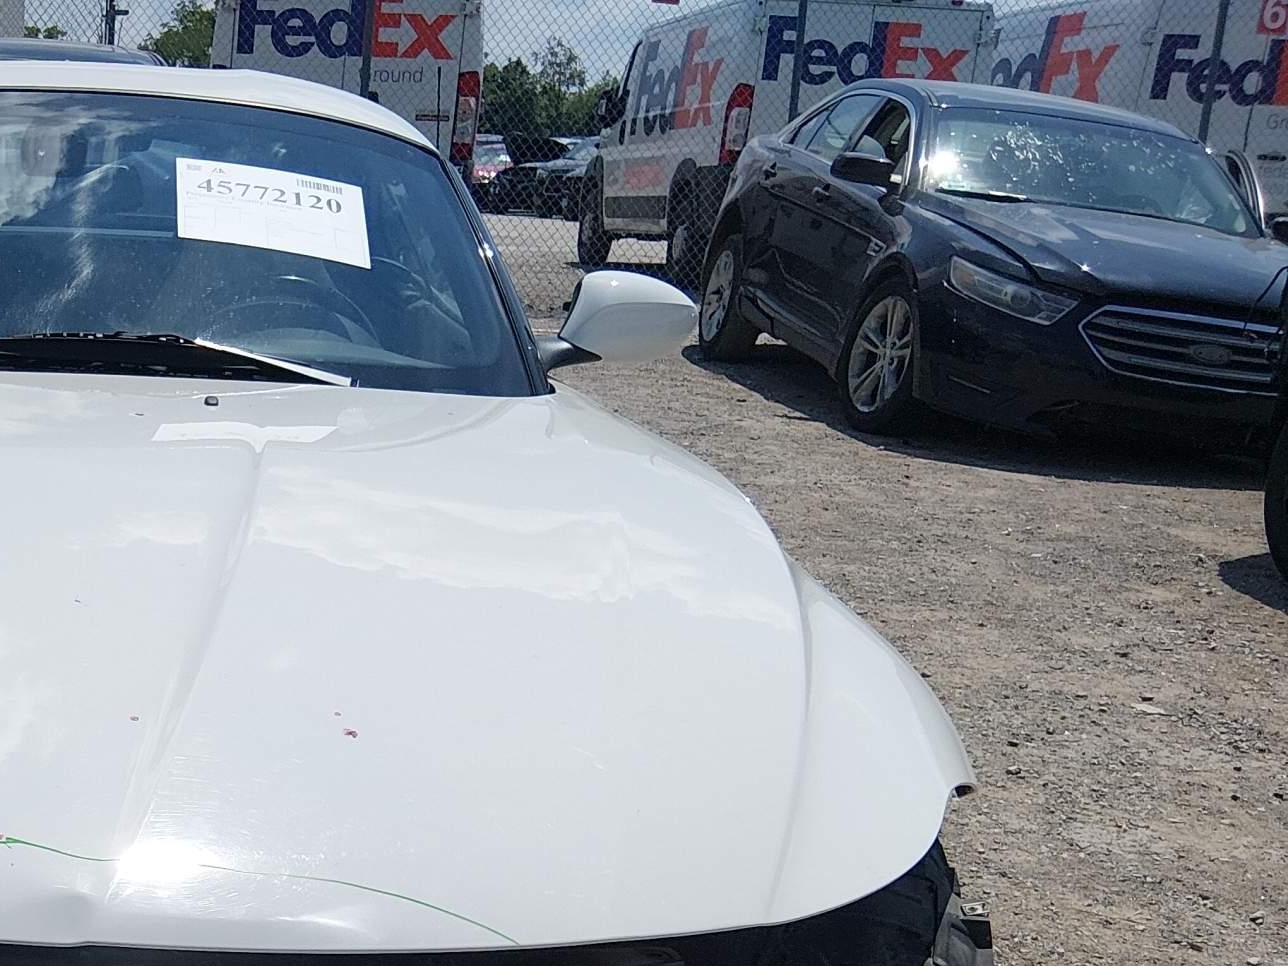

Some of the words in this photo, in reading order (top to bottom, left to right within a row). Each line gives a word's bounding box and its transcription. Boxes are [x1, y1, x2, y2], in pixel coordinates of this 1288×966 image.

[236, 0, 457, 60] FedEx
[760, 14, 969, 86] FedEx
[630, 26, 724, 137] FedEx
[197, 178, 343, 214] 45772120
